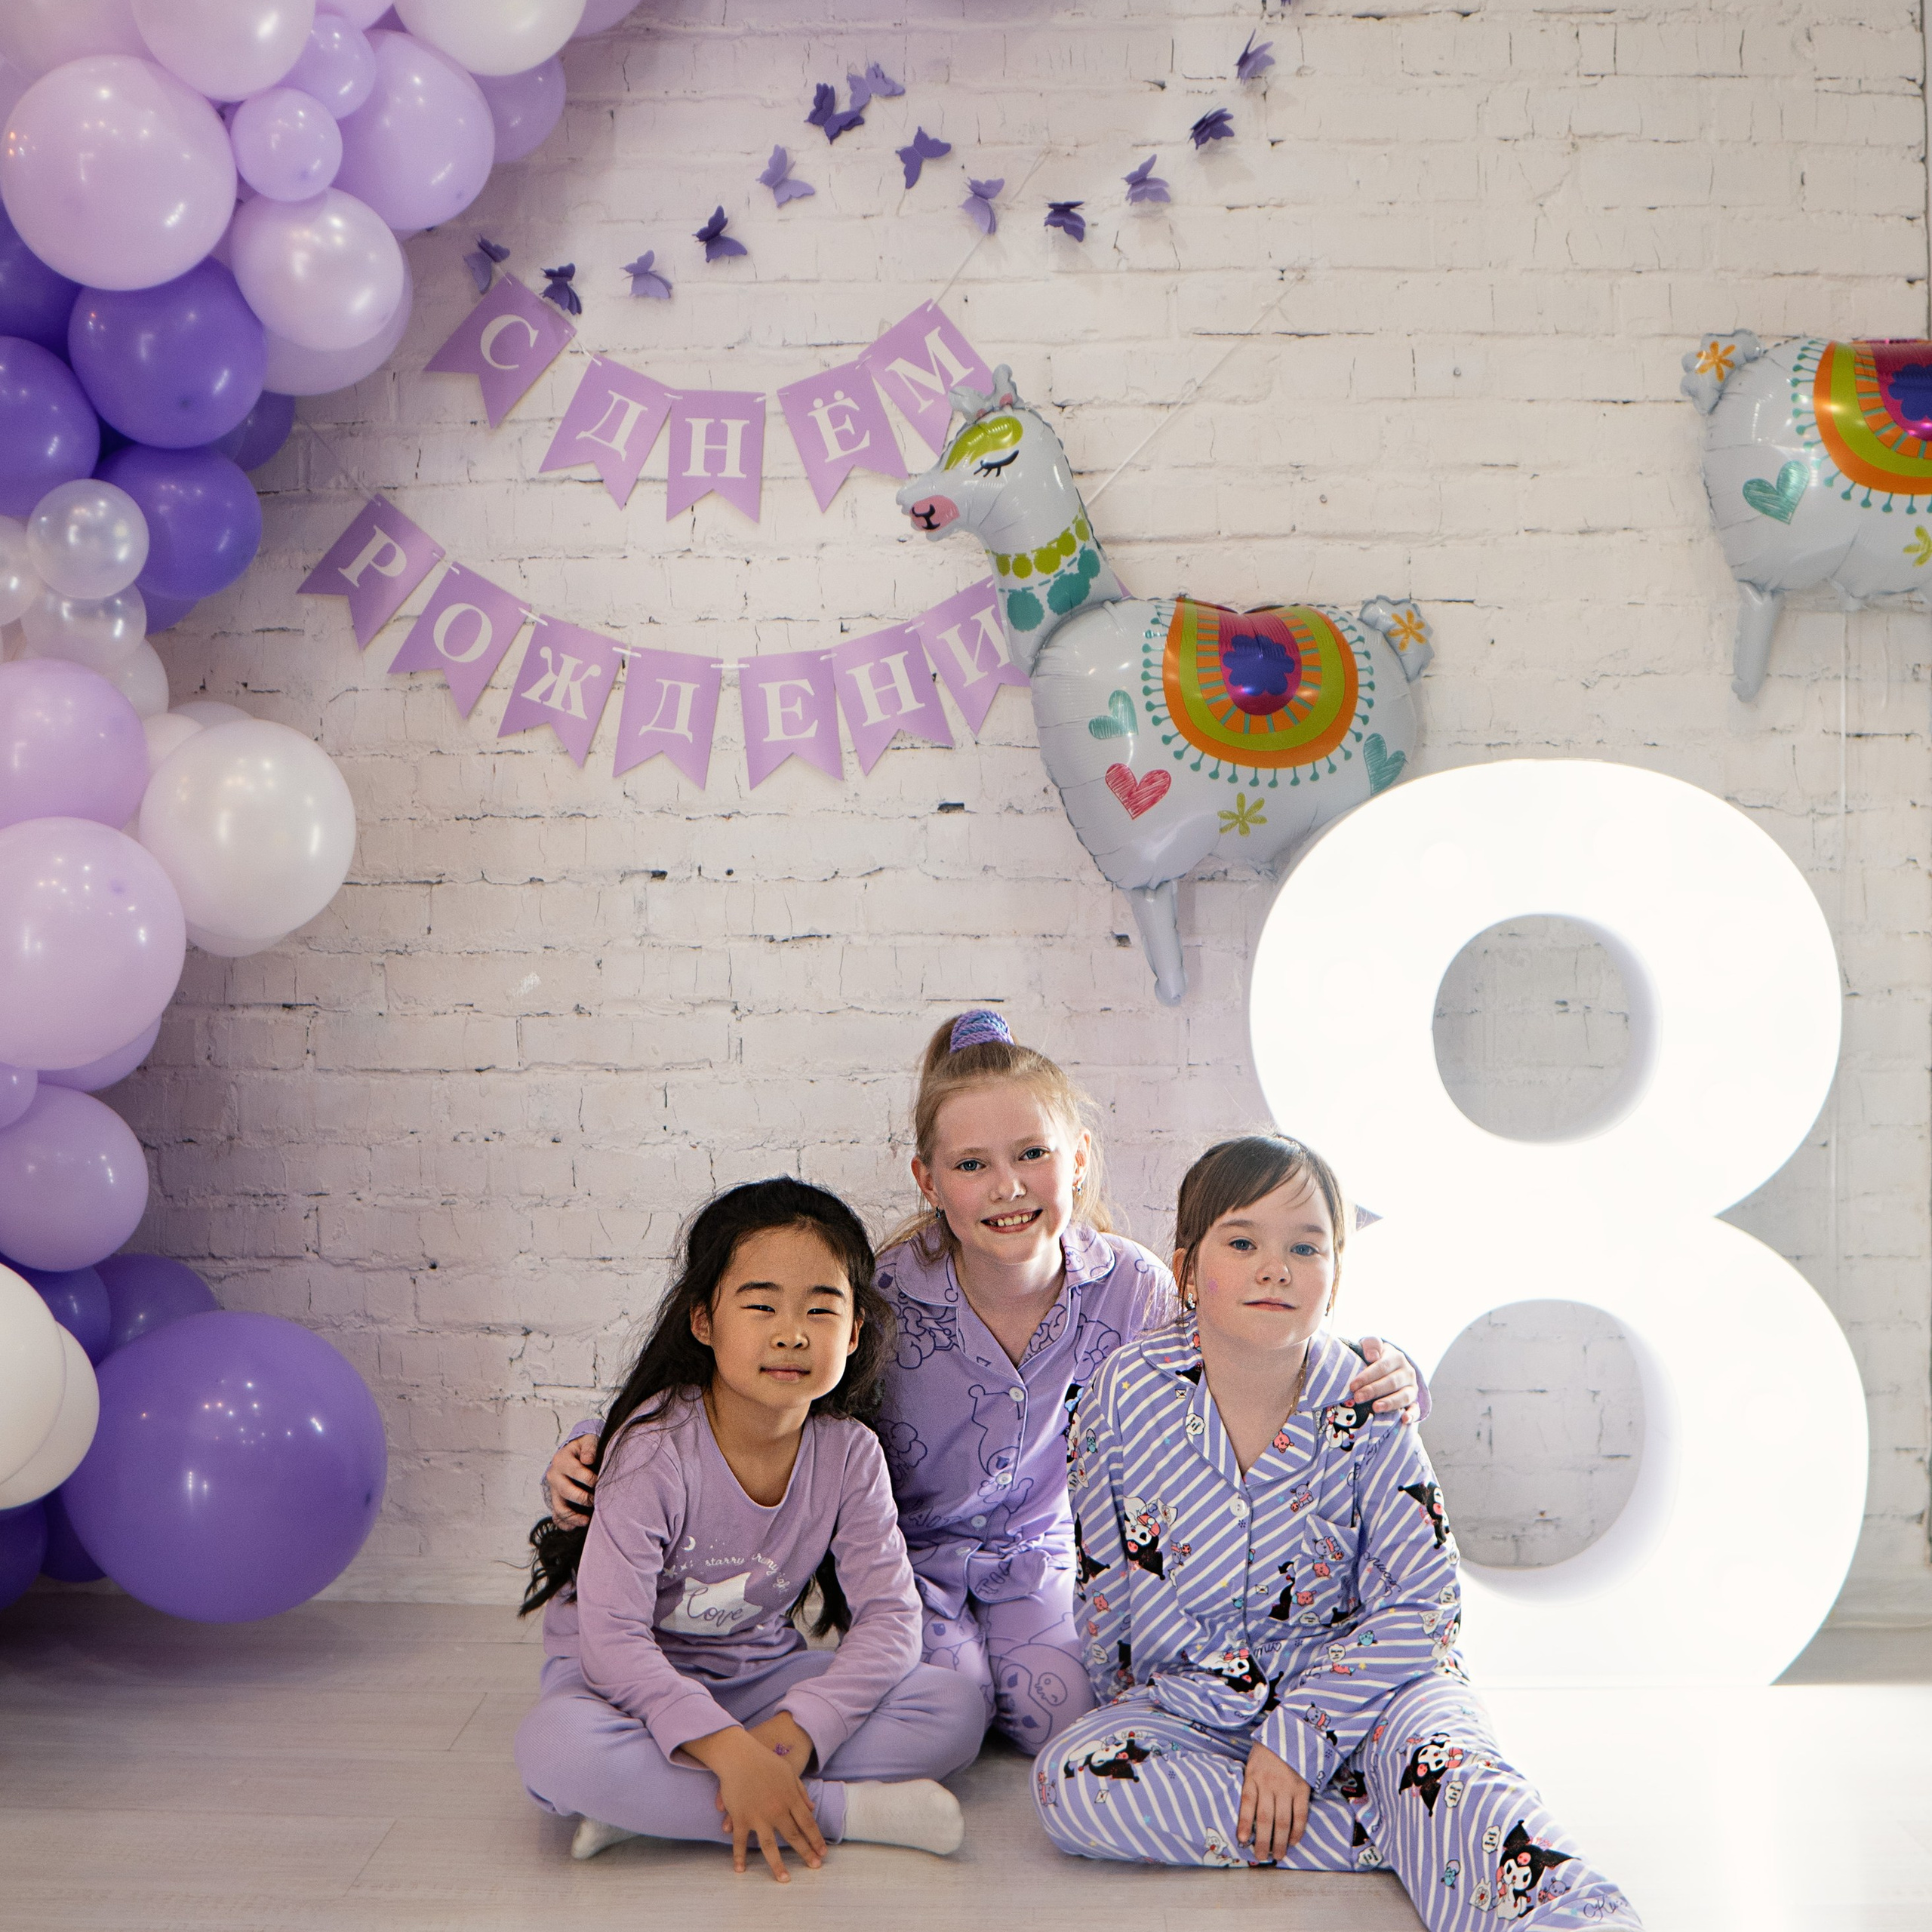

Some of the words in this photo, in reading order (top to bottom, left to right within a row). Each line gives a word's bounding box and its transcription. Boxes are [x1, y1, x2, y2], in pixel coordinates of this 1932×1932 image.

[480, 314, 539, 370] С
[576, 326, 974, 479] ДНЁМ
[337, 525, 1012, 743] РОЖДЕНИ
[1249, 757, 1870, 1686] 8
[687, 1586, 743, 1627] Love
